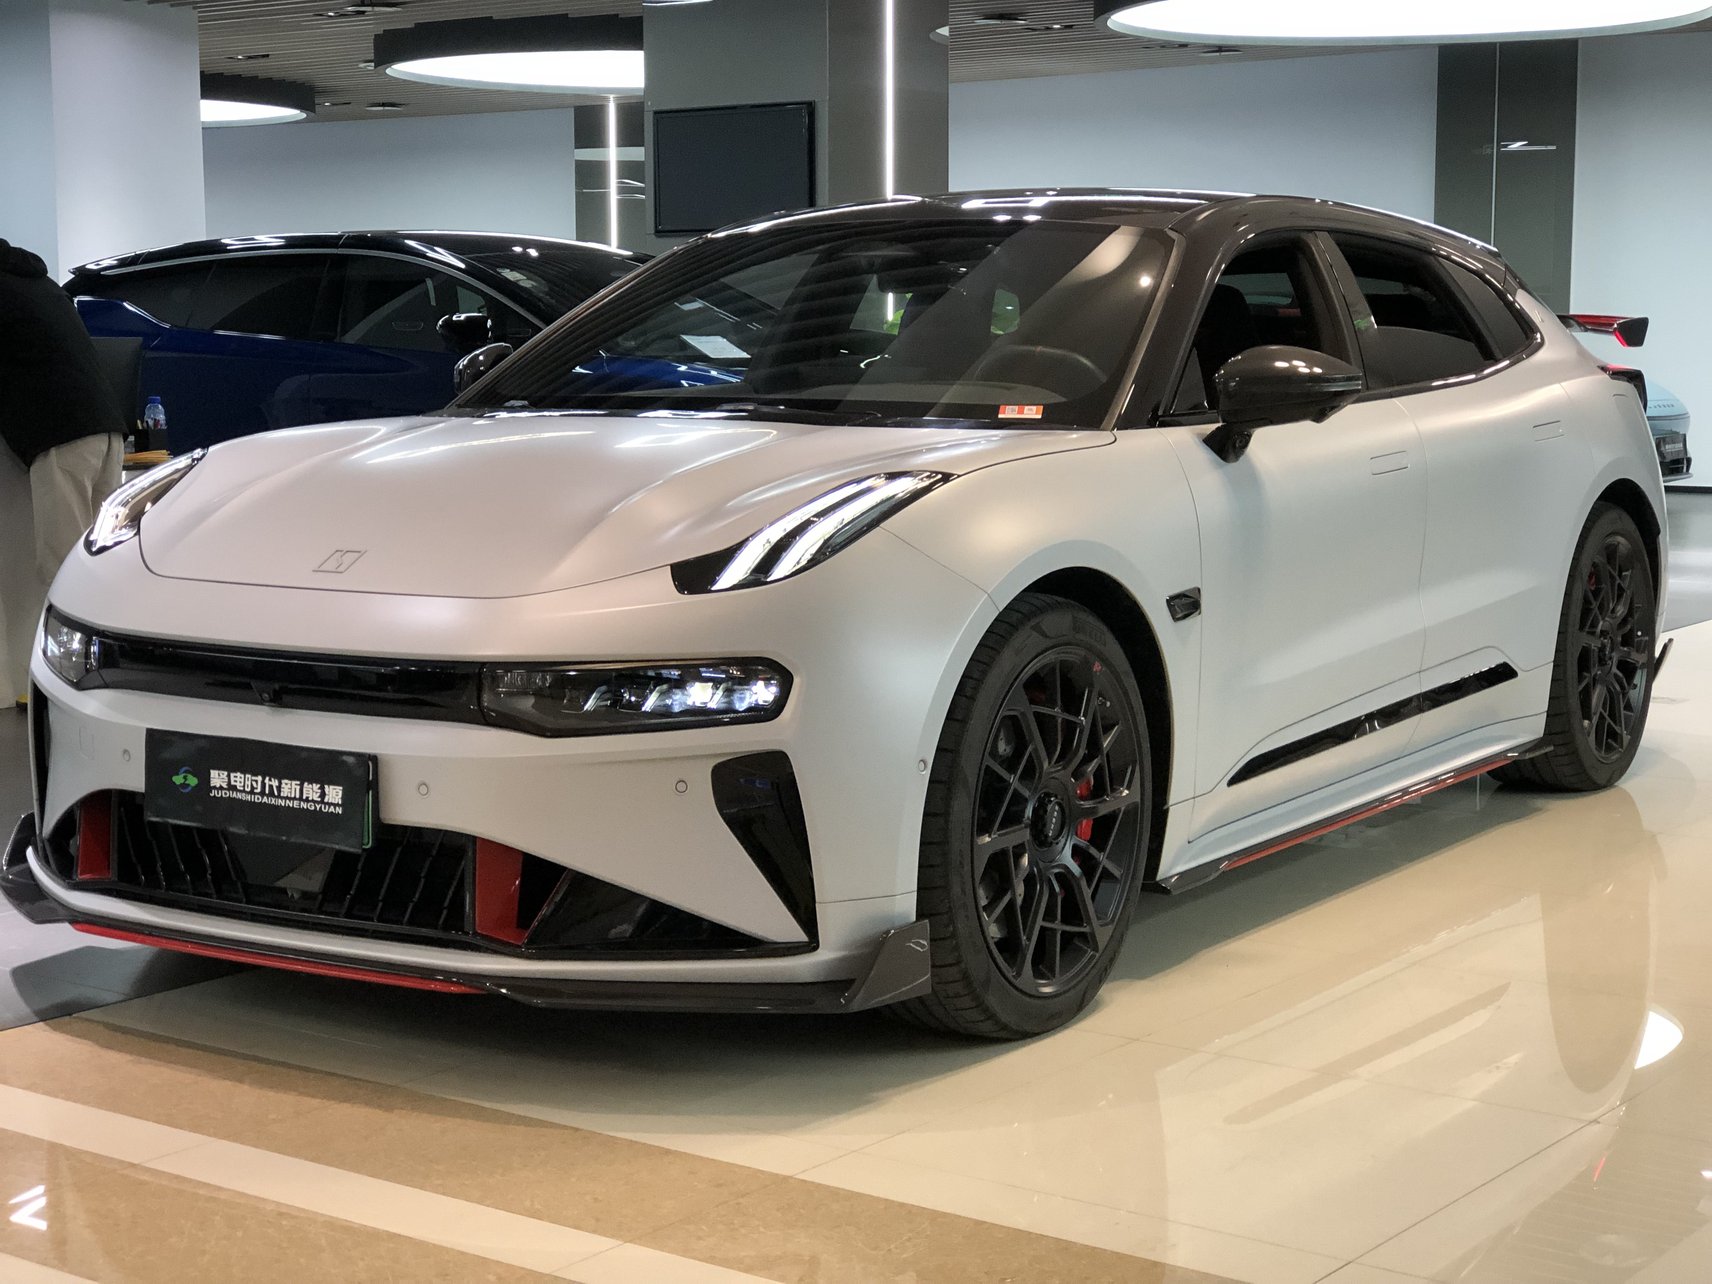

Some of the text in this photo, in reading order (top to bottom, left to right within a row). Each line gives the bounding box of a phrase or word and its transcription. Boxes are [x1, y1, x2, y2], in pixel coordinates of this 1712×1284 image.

[209, 789, 343, 814] JUDIANSHIDAIXINNENGYUAN
[210, 769, 343, 804] 聚电时代新能源
